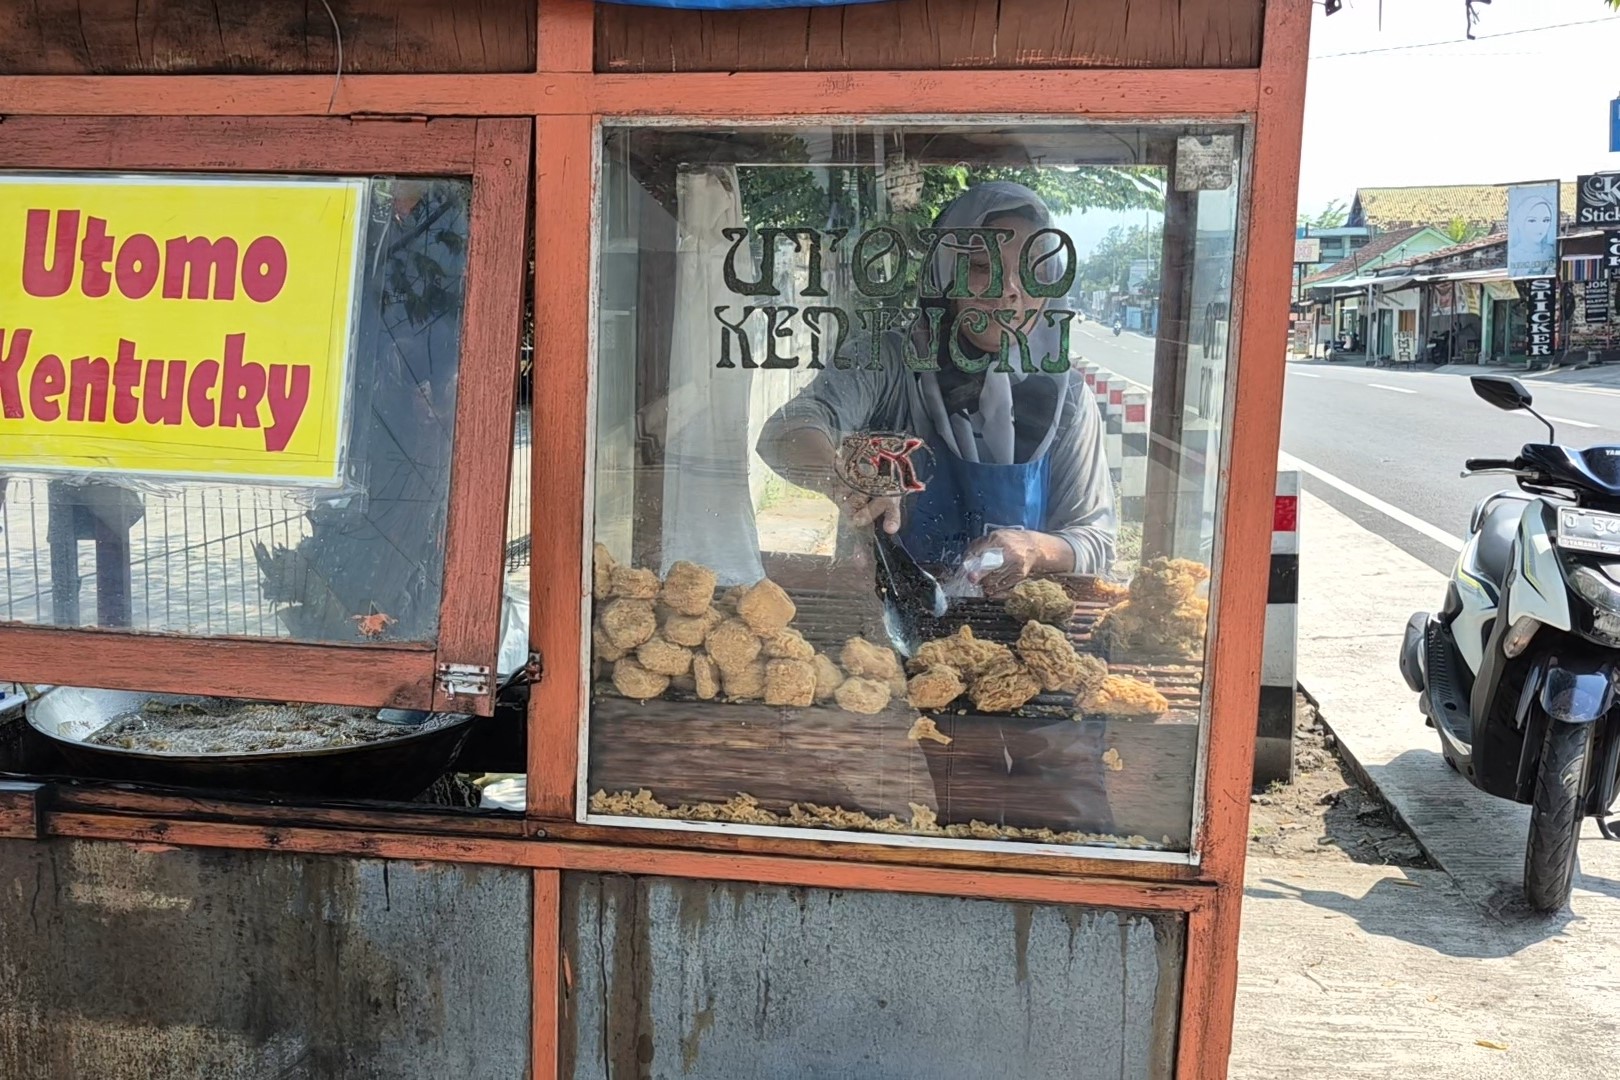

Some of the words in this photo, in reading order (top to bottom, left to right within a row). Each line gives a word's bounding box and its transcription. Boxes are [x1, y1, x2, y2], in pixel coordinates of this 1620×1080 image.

[22, 209, 288, 303] Utomo
[721, 227, 1078, 299] UTOMO
[1586, 280, 1608, 289] JOK
[1530, 280, 1551, 355] STICKER
[0, 328, 311, 452] Kentucky
